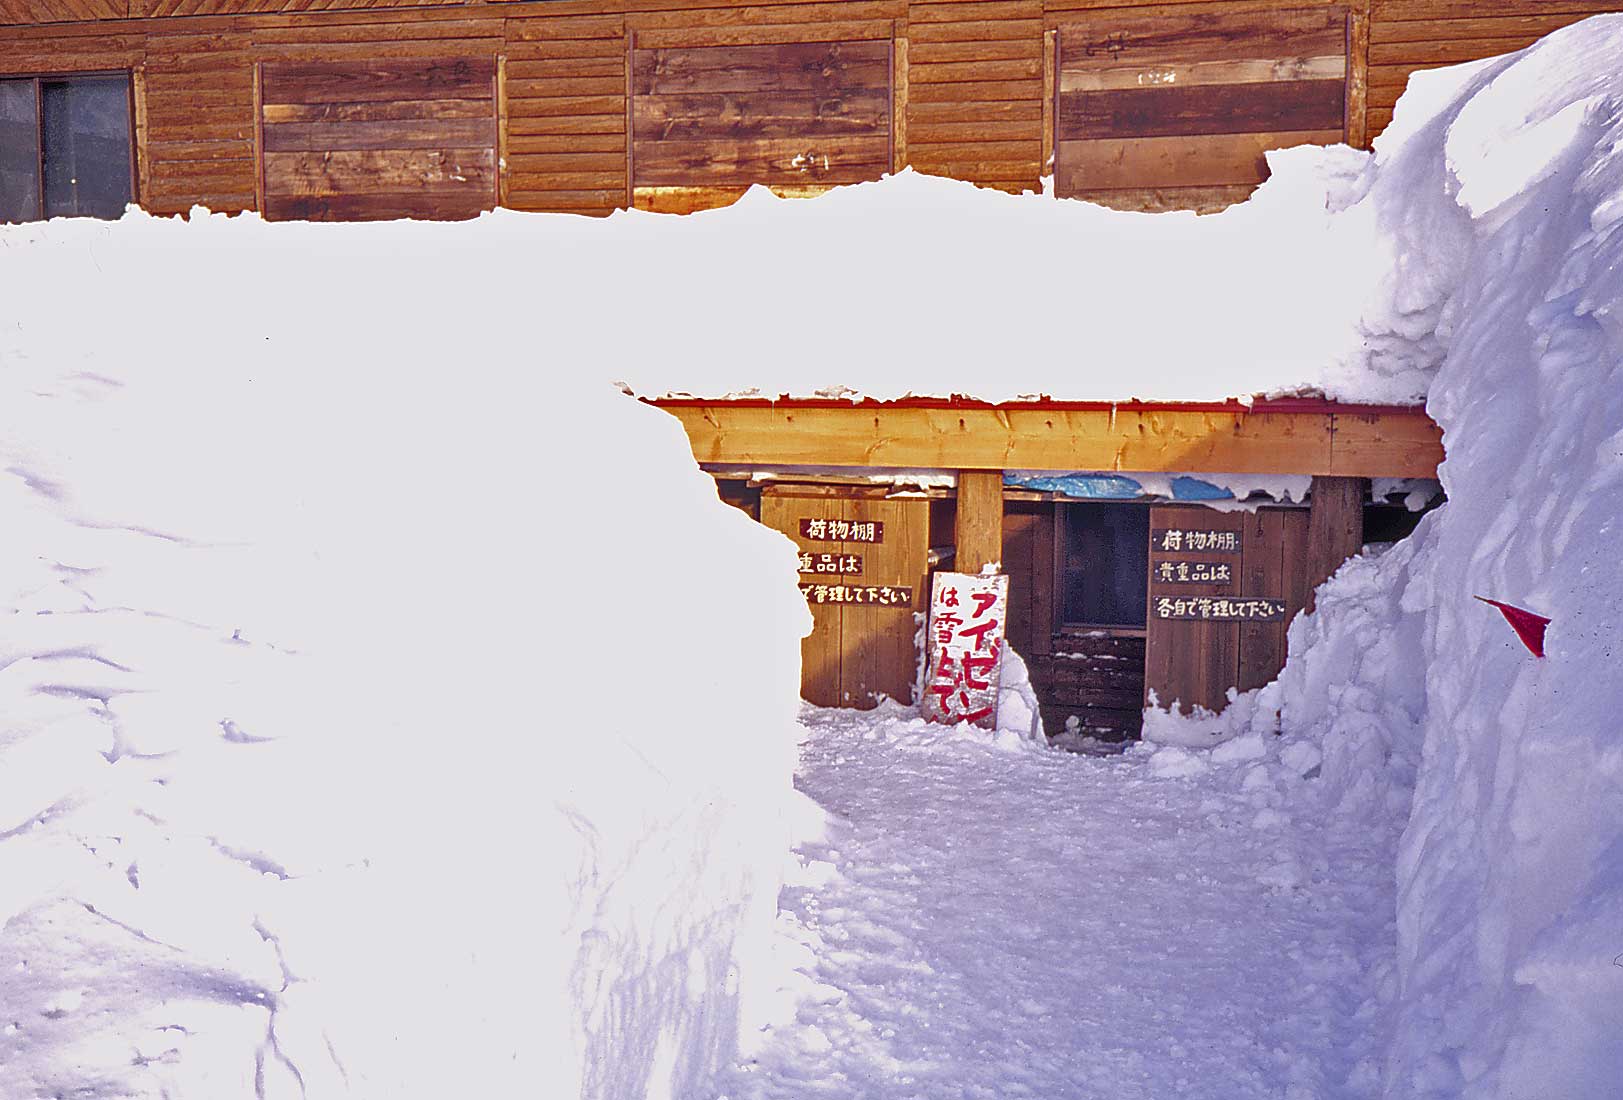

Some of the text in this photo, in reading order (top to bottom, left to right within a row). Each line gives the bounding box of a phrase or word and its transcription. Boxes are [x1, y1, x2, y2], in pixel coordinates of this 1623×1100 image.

[806, 519, 875, 541] 荷物棚
[1161, 529, 1235, 550] 荷物棚
[1159, 562, 1230, 582] 貴重品は
[1157, 598, 1283, 618] 各自で管理して下さい
[957, 593, 1001, 725] アイゼン
